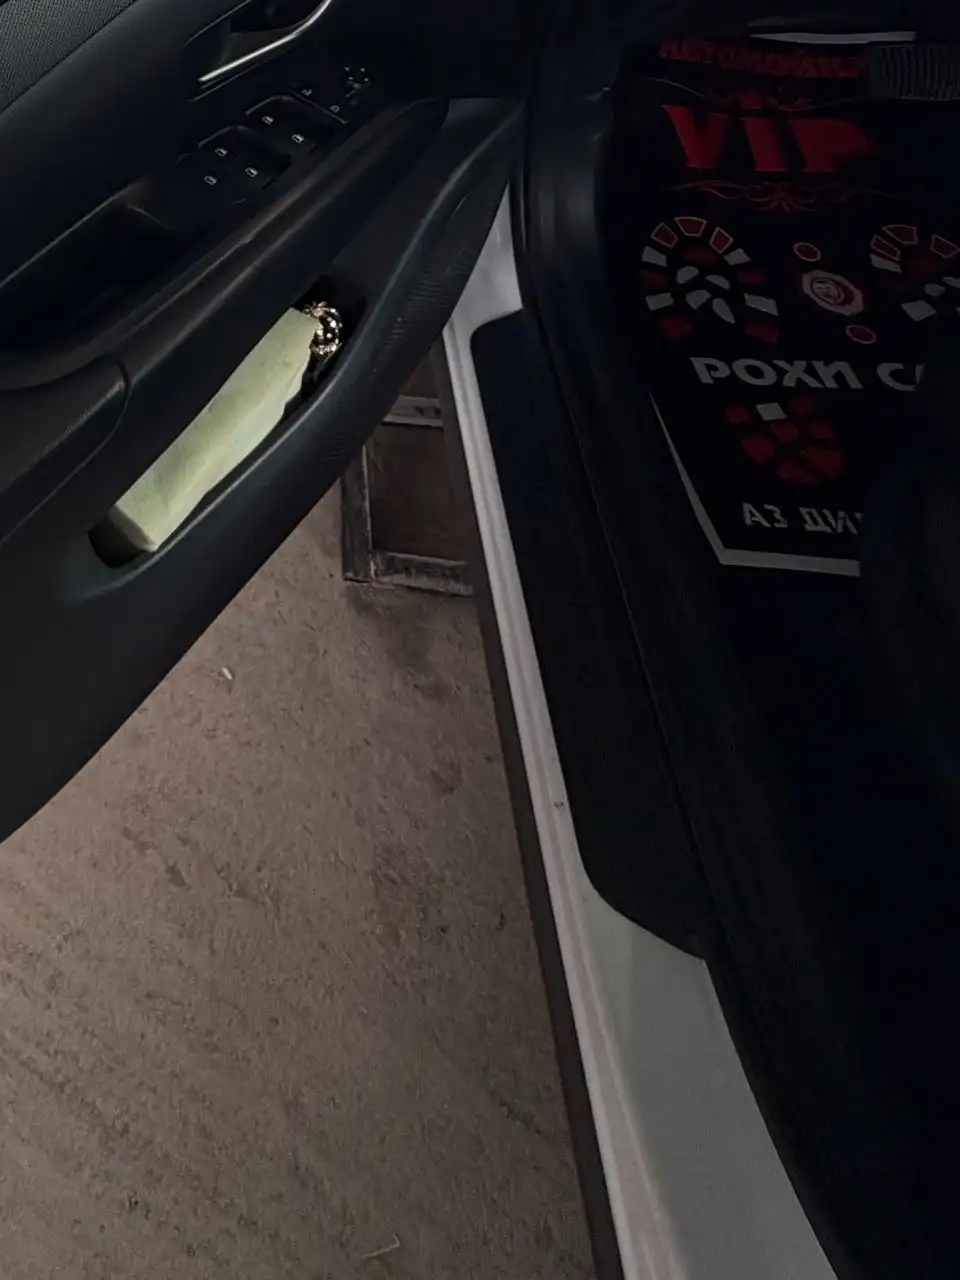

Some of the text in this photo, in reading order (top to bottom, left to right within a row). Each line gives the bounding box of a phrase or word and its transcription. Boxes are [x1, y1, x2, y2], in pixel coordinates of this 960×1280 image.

[660, 104, 877, 174] VIP
[741, 501, 864, 536] АЗ ДИ
